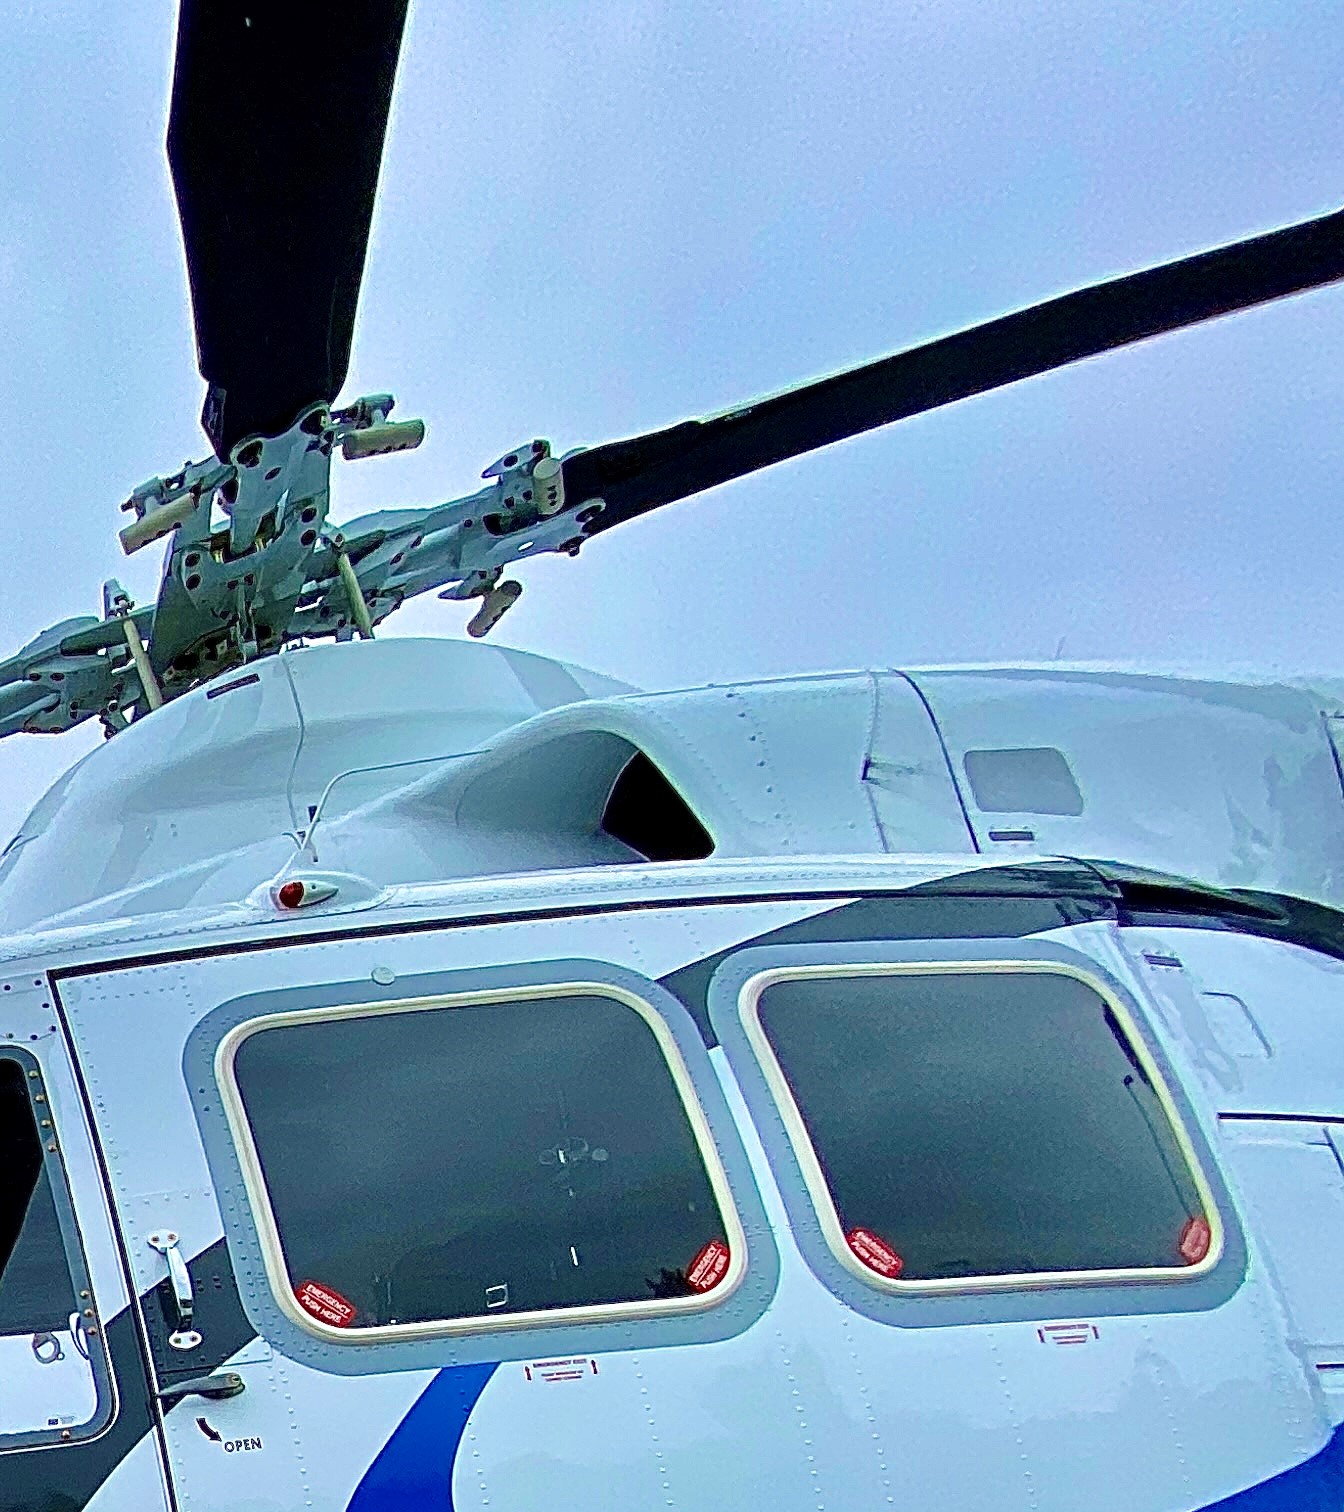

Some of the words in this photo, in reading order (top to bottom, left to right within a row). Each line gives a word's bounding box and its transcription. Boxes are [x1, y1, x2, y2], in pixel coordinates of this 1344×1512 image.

[689, 1244, 717, 1283] EMERGENCY
[301, 1294, 321, 1312] PUSH
[319, 1308, 342, 1323] HERE
[306, 1284, 351, 1314] EMERGENCY
[224, 1437, 262, 1453] OPEN
